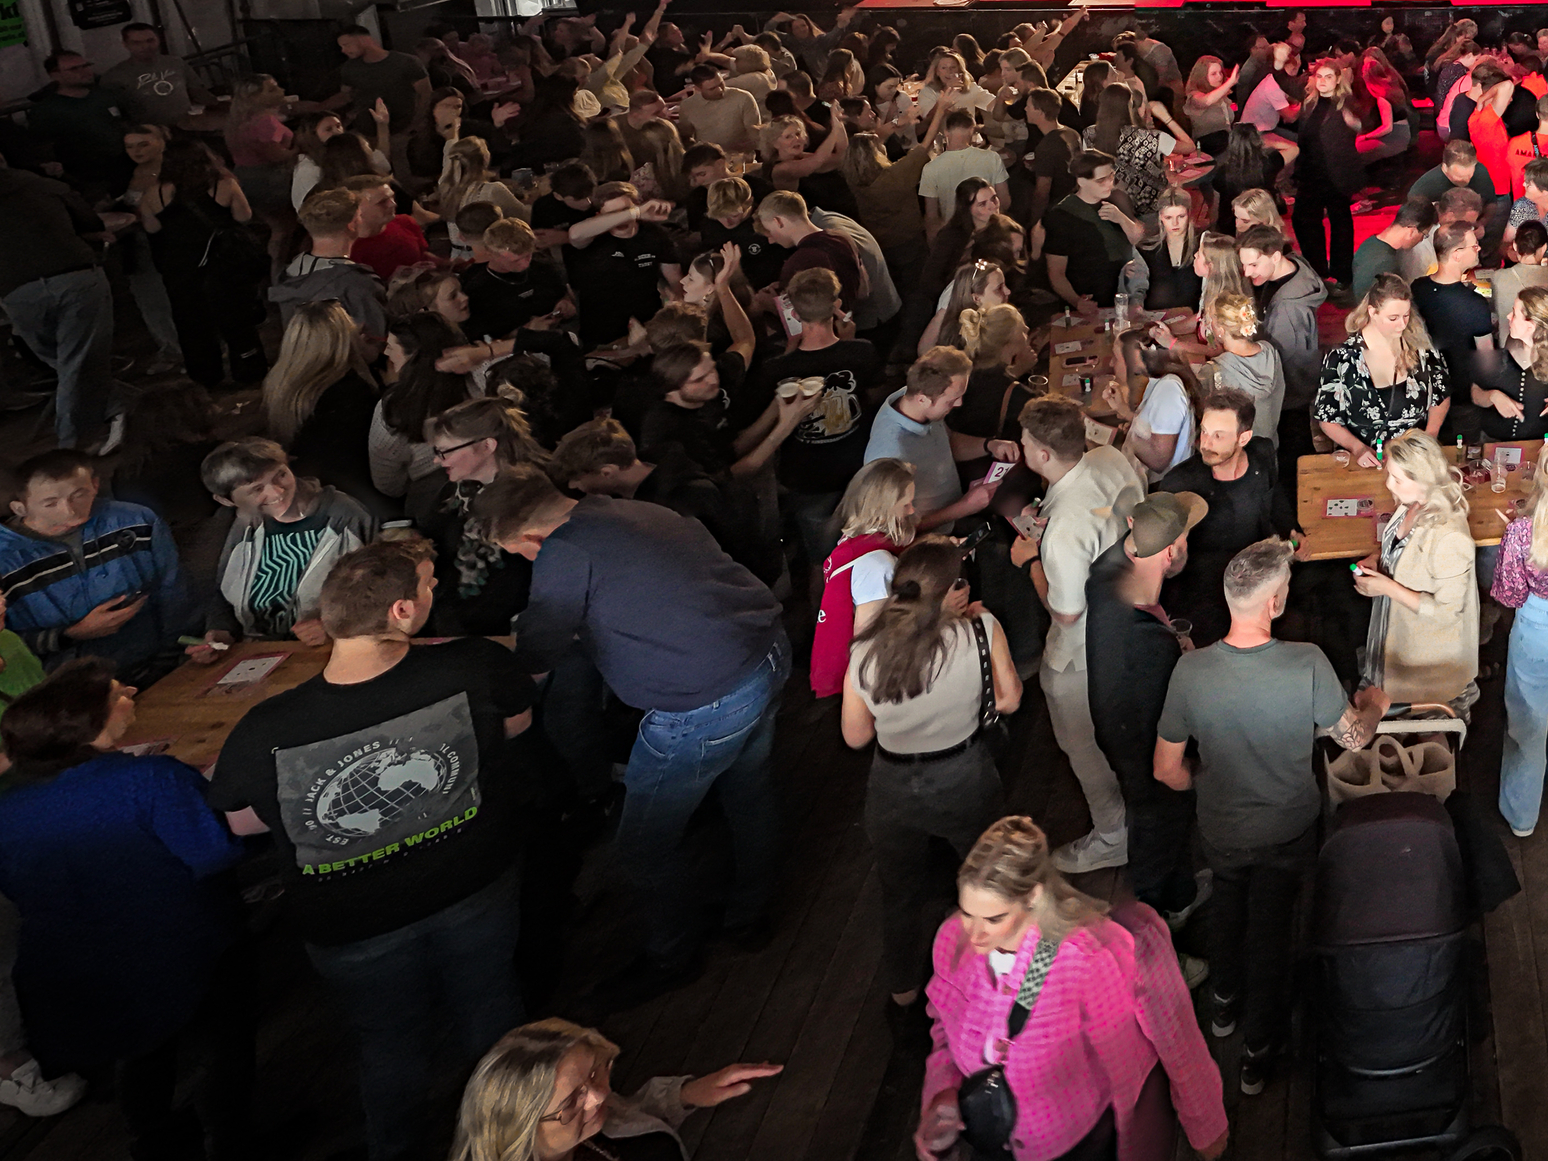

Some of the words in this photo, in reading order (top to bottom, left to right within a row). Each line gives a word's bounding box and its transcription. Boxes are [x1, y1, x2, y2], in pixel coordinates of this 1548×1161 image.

[305, 776, 327, 804] JACK
[324, 767, 336, 778] &
[336, 740, 381, 769] JONES
[302, 863, 316, 876] A
[318, 841, 401, 875] BETTER
[404, 805, 479, 848] WORLD
